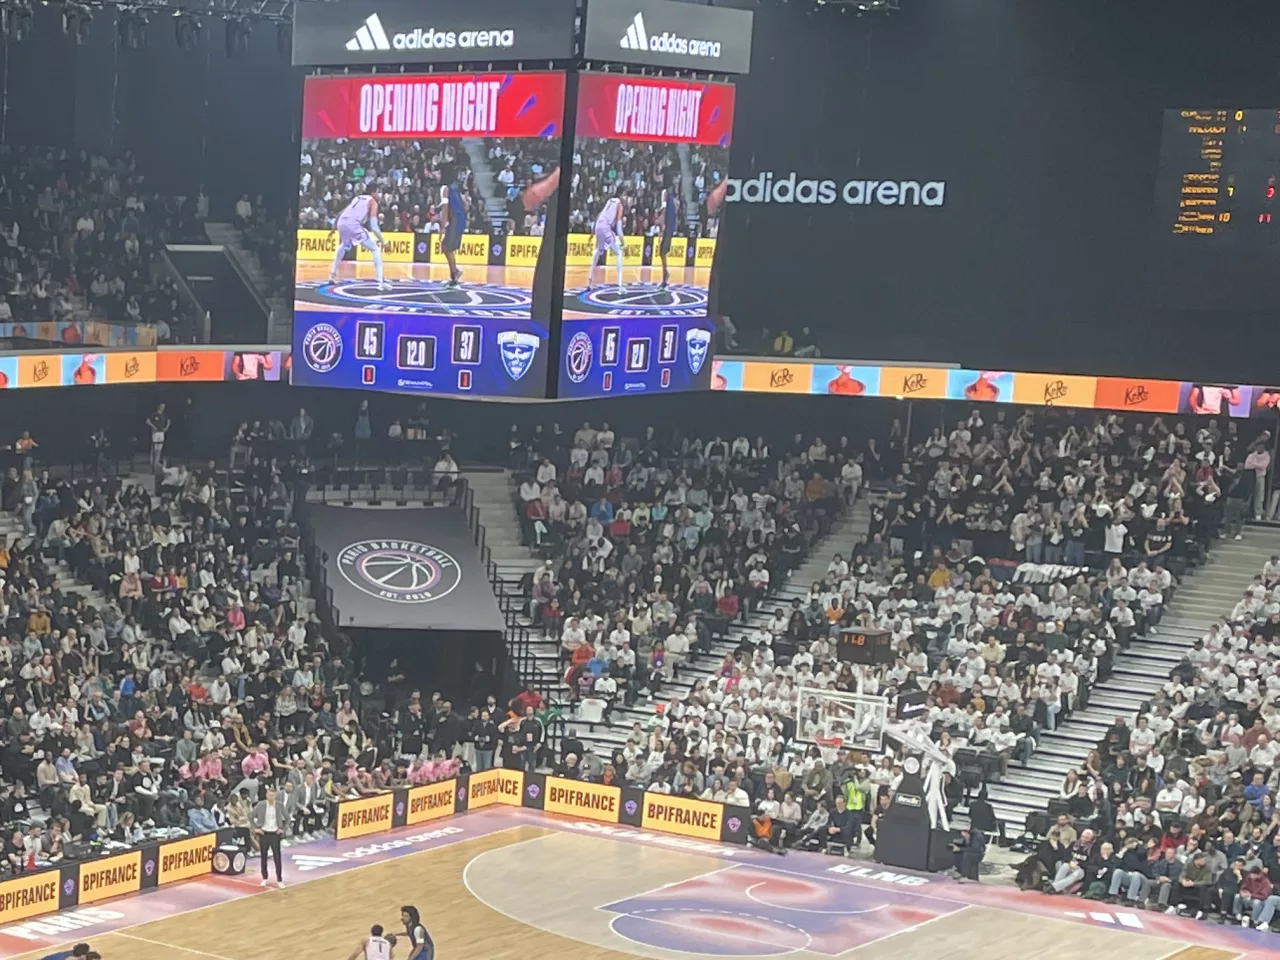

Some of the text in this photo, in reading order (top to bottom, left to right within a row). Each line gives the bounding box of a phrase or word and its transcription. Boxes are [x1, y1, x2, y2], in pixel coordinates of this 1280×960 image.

[392, 28, 515, 49] adidas arena
[650, 32, 721, 57] adidas arena
[359, 81, 501, 133] OPENING NIGHT
[615, 83, 702, 138] OPENING NIGHT
[724, 172, 945, 206] adidas arena
[362, 326, 378, 356] 45
[406, 341, 426, 366] 12.0
[460, 329, 475, 360] 37
[341, 540, 454, 569] PARIS BASKETBALL
[410, 789, 453, 814] BPIFRANCE
[470, 779, 519, 799] BPIFRANCE
[549, 786, 616, 812] BPIFRANCE
[341, 804, 390, 829] BPIFRANCE
[647, 802, 718, 829] BPIFRANCE
[342, 826, 464, 859] adidas arena
[162, 844, 214, 872] BPIFRANCE
[83, 862, 138, 892] BPIFRANCE
